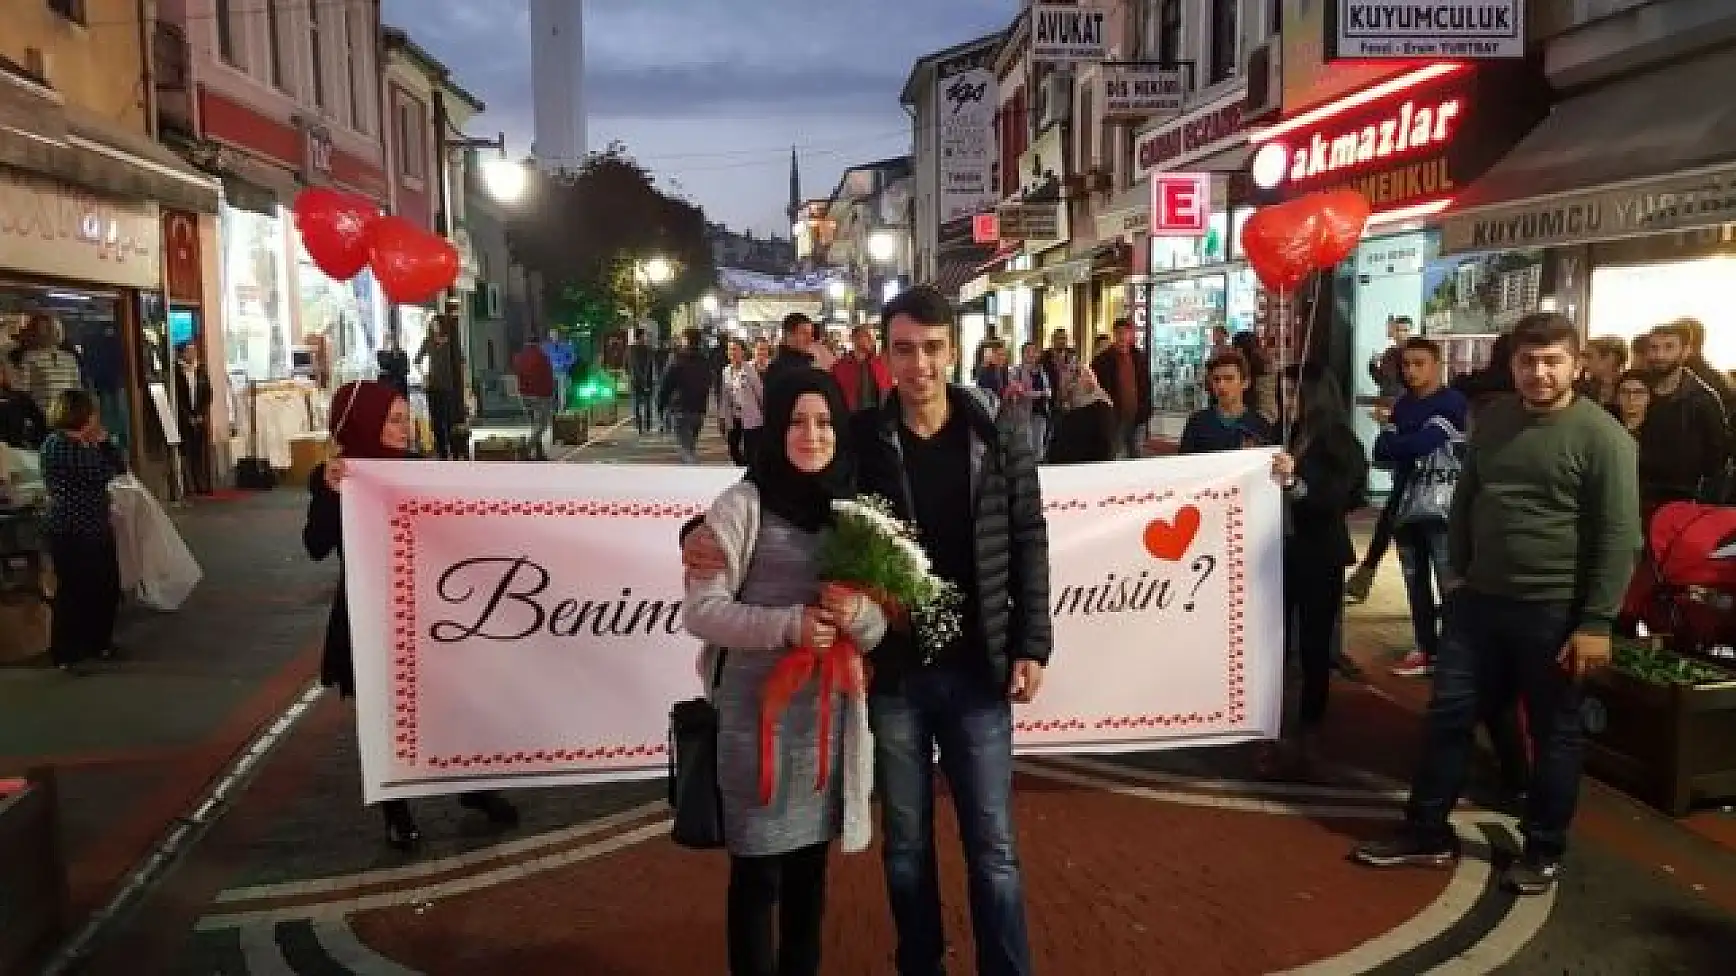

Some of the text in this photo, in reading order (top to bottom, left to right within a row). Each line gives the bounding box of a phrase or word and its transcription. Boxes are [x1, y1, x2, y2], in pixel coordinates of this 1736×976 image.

[1037, 10, 1104, 44] AVUKAT
[1349, 5, 1509, 30] KUYUMCULUK
[1165, 183, 1196, 226] E
[1474, 203, 1602, 247] KUYUMCU
[429, 554, 1216, 642] Benim misin ?
